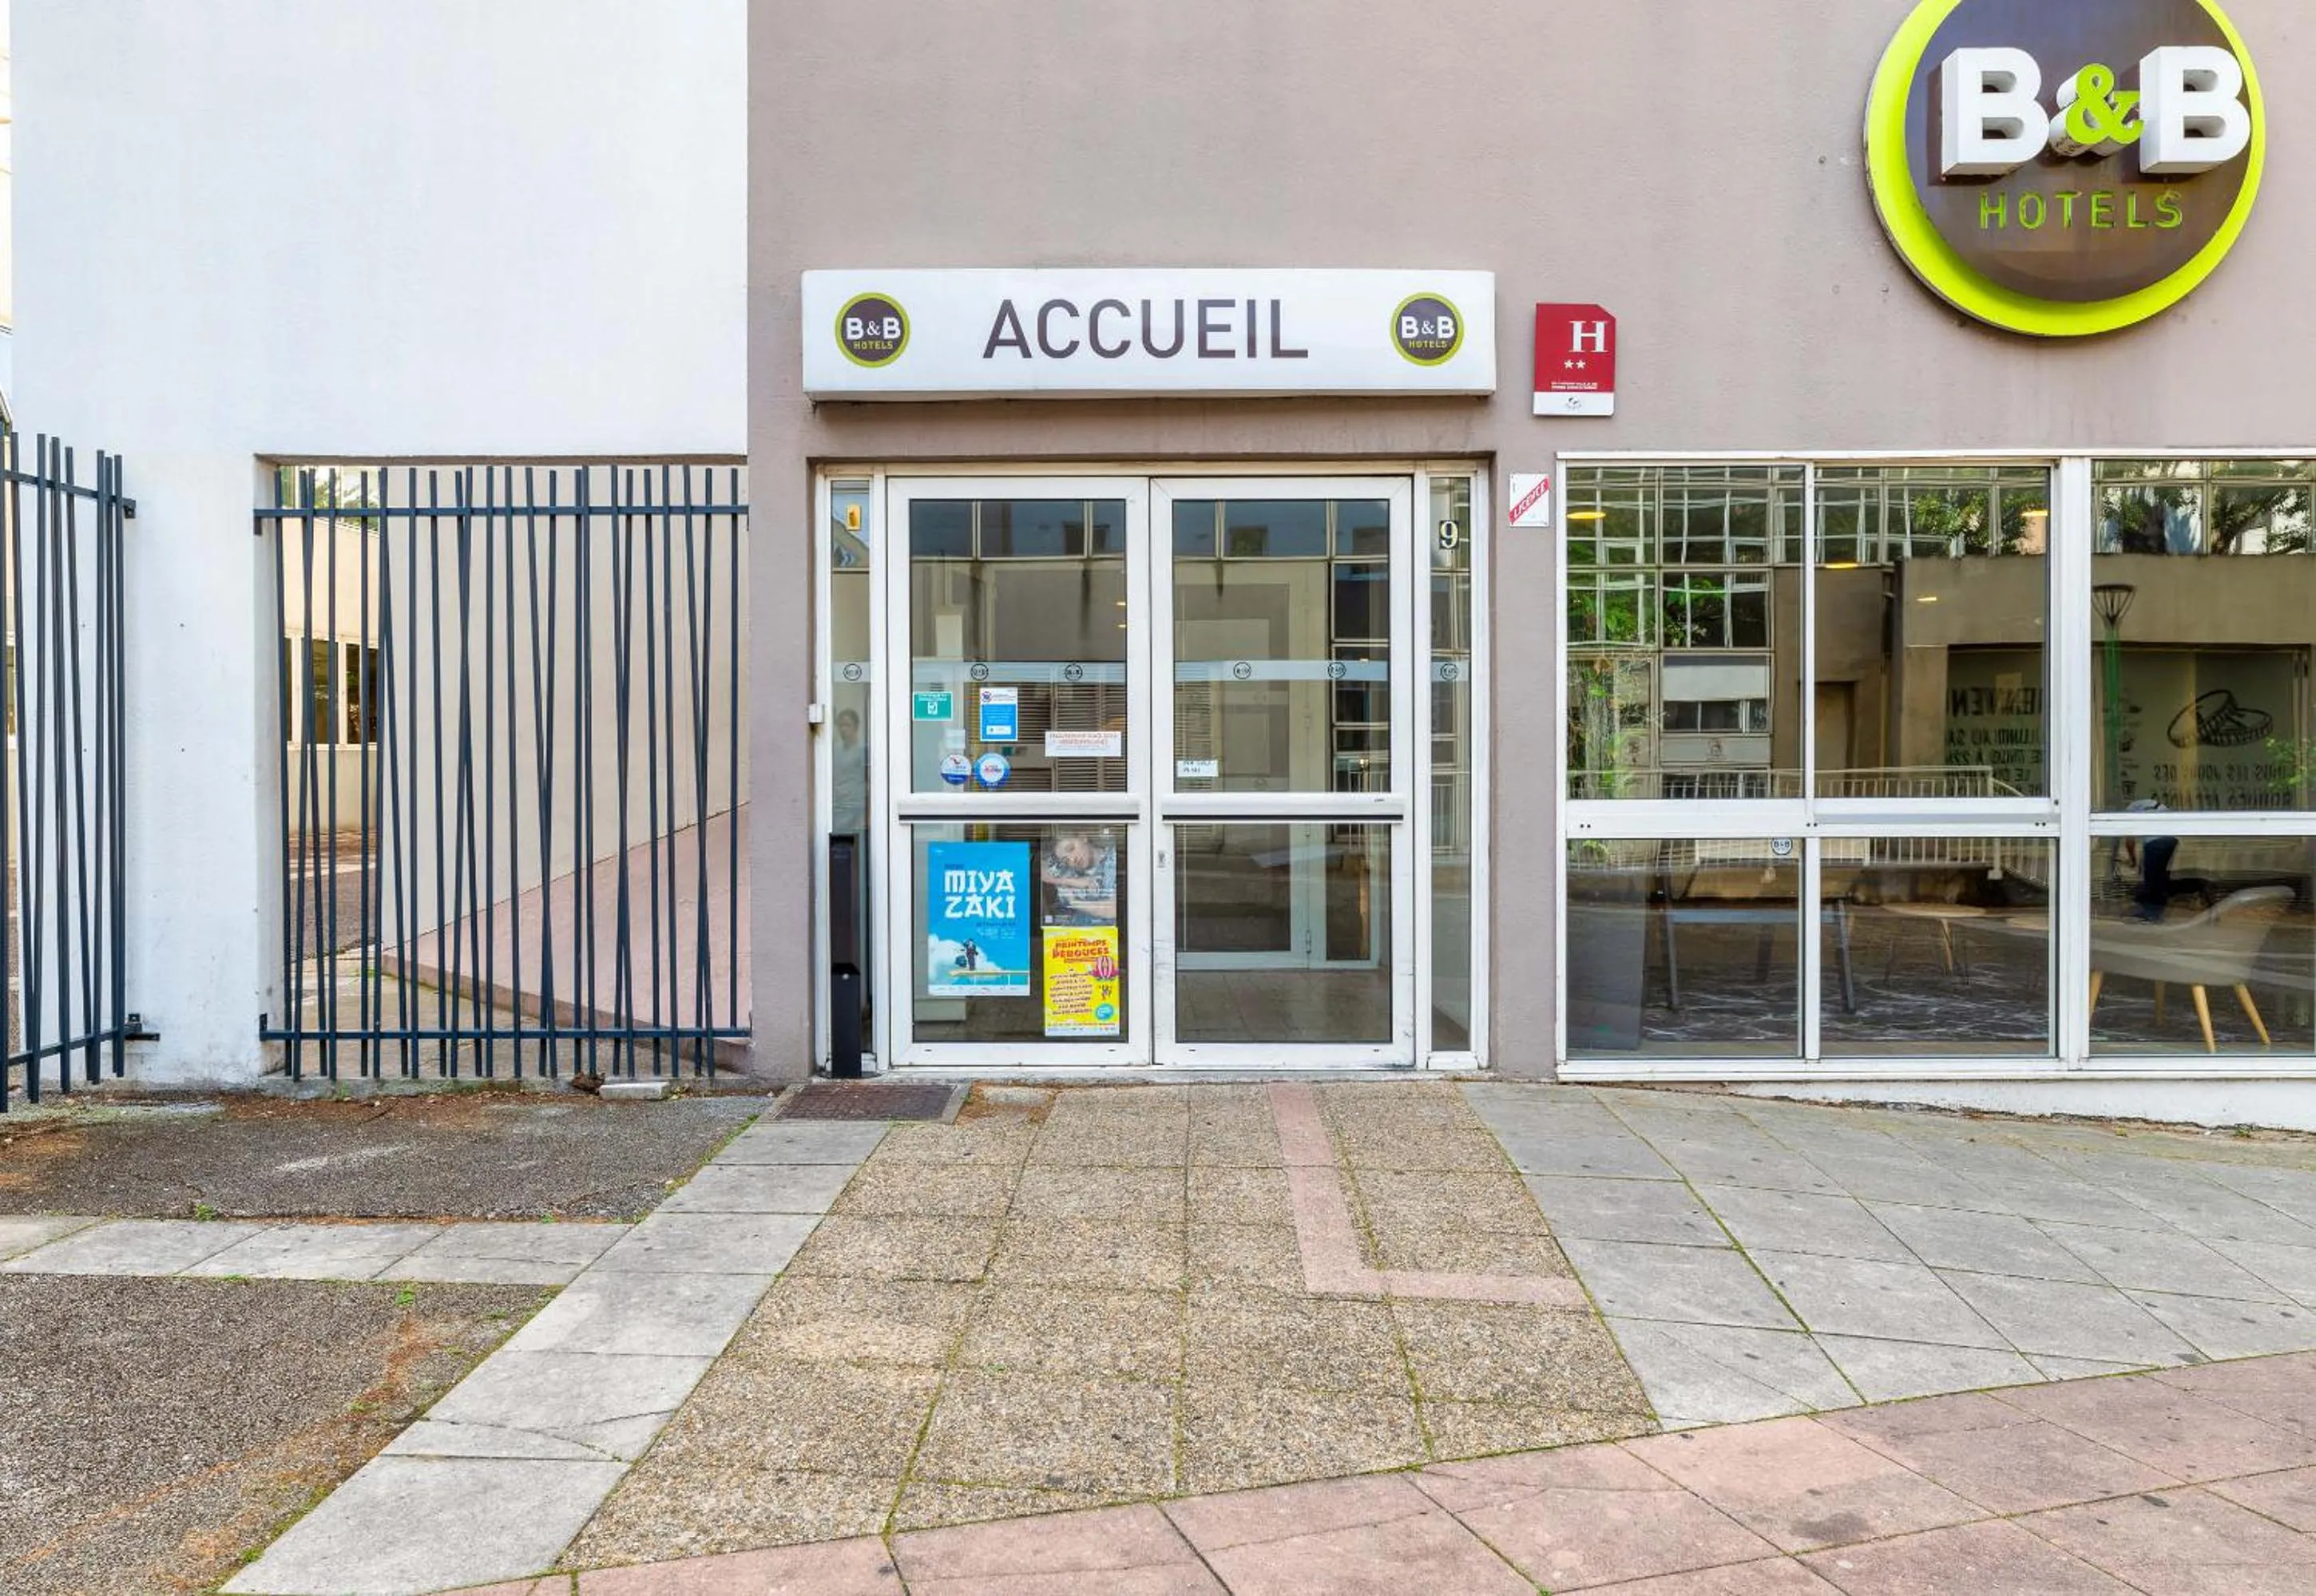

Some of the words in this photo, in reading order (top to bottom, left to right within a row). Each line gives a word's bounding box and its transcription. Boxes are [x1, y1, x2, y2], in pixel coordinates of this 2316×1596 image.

[1941, 46, 2251, 176] B&B
[1979, 190, 2183, 230] HOTELS
[846, 317, 901, 339] B&B
[982, 298, 1308, 358] ACCUEIL
[1401, 315, 1455, 339] B&B
[1568, 320, 1609, 353] H
[853, 340, 894, 350] HOTELS
[1409, 339, 1448, 349] HOTELS
[1440, 521, 1458, 549] 9
[944, 869, 1015, 894] MIYA
[944, 895, 1016, 919] ZAKI
